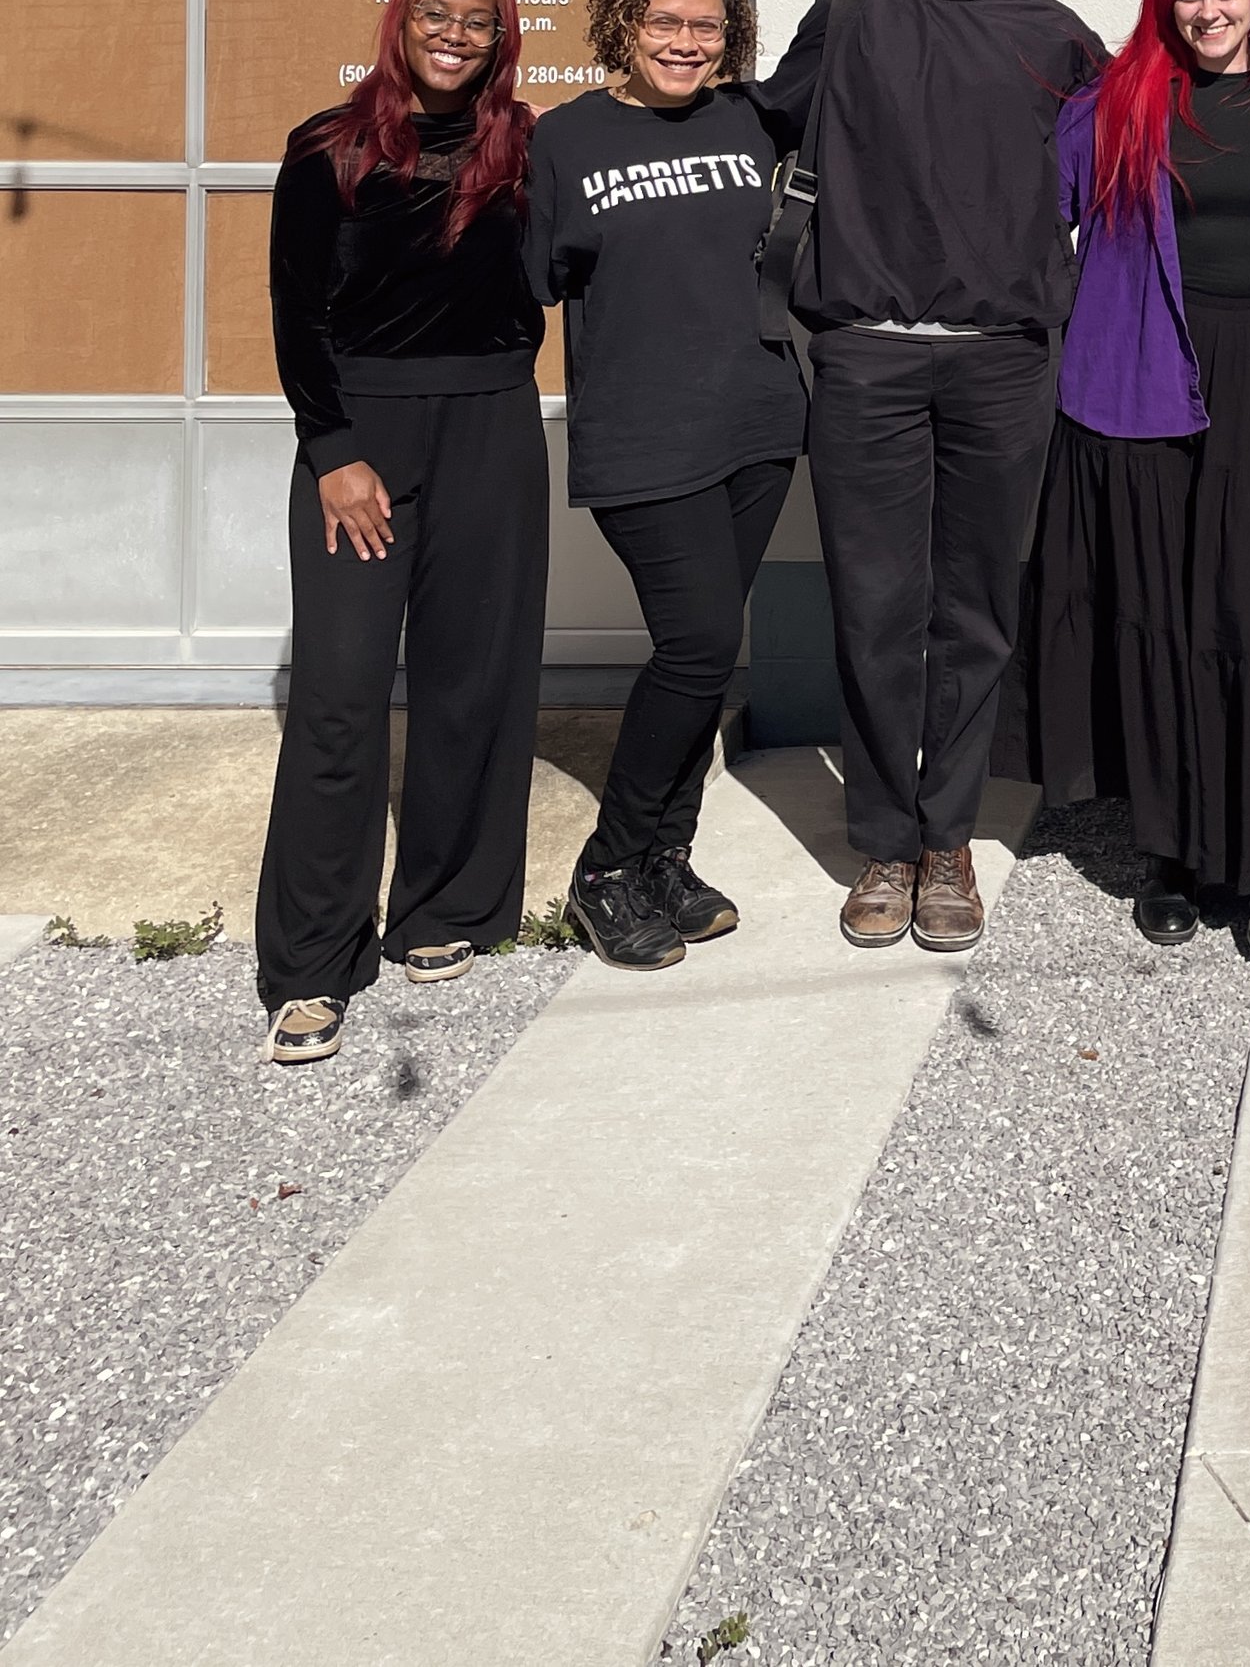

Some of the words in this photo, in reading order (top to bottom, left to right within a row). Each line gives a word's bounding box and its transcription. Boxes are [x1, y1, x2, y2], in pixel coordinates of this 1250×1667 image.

[519, 17, 557, 35] p.m.
[527, 65, 605, 84] 280-6410
[582, 153, 762, 215] HARRIETTS
